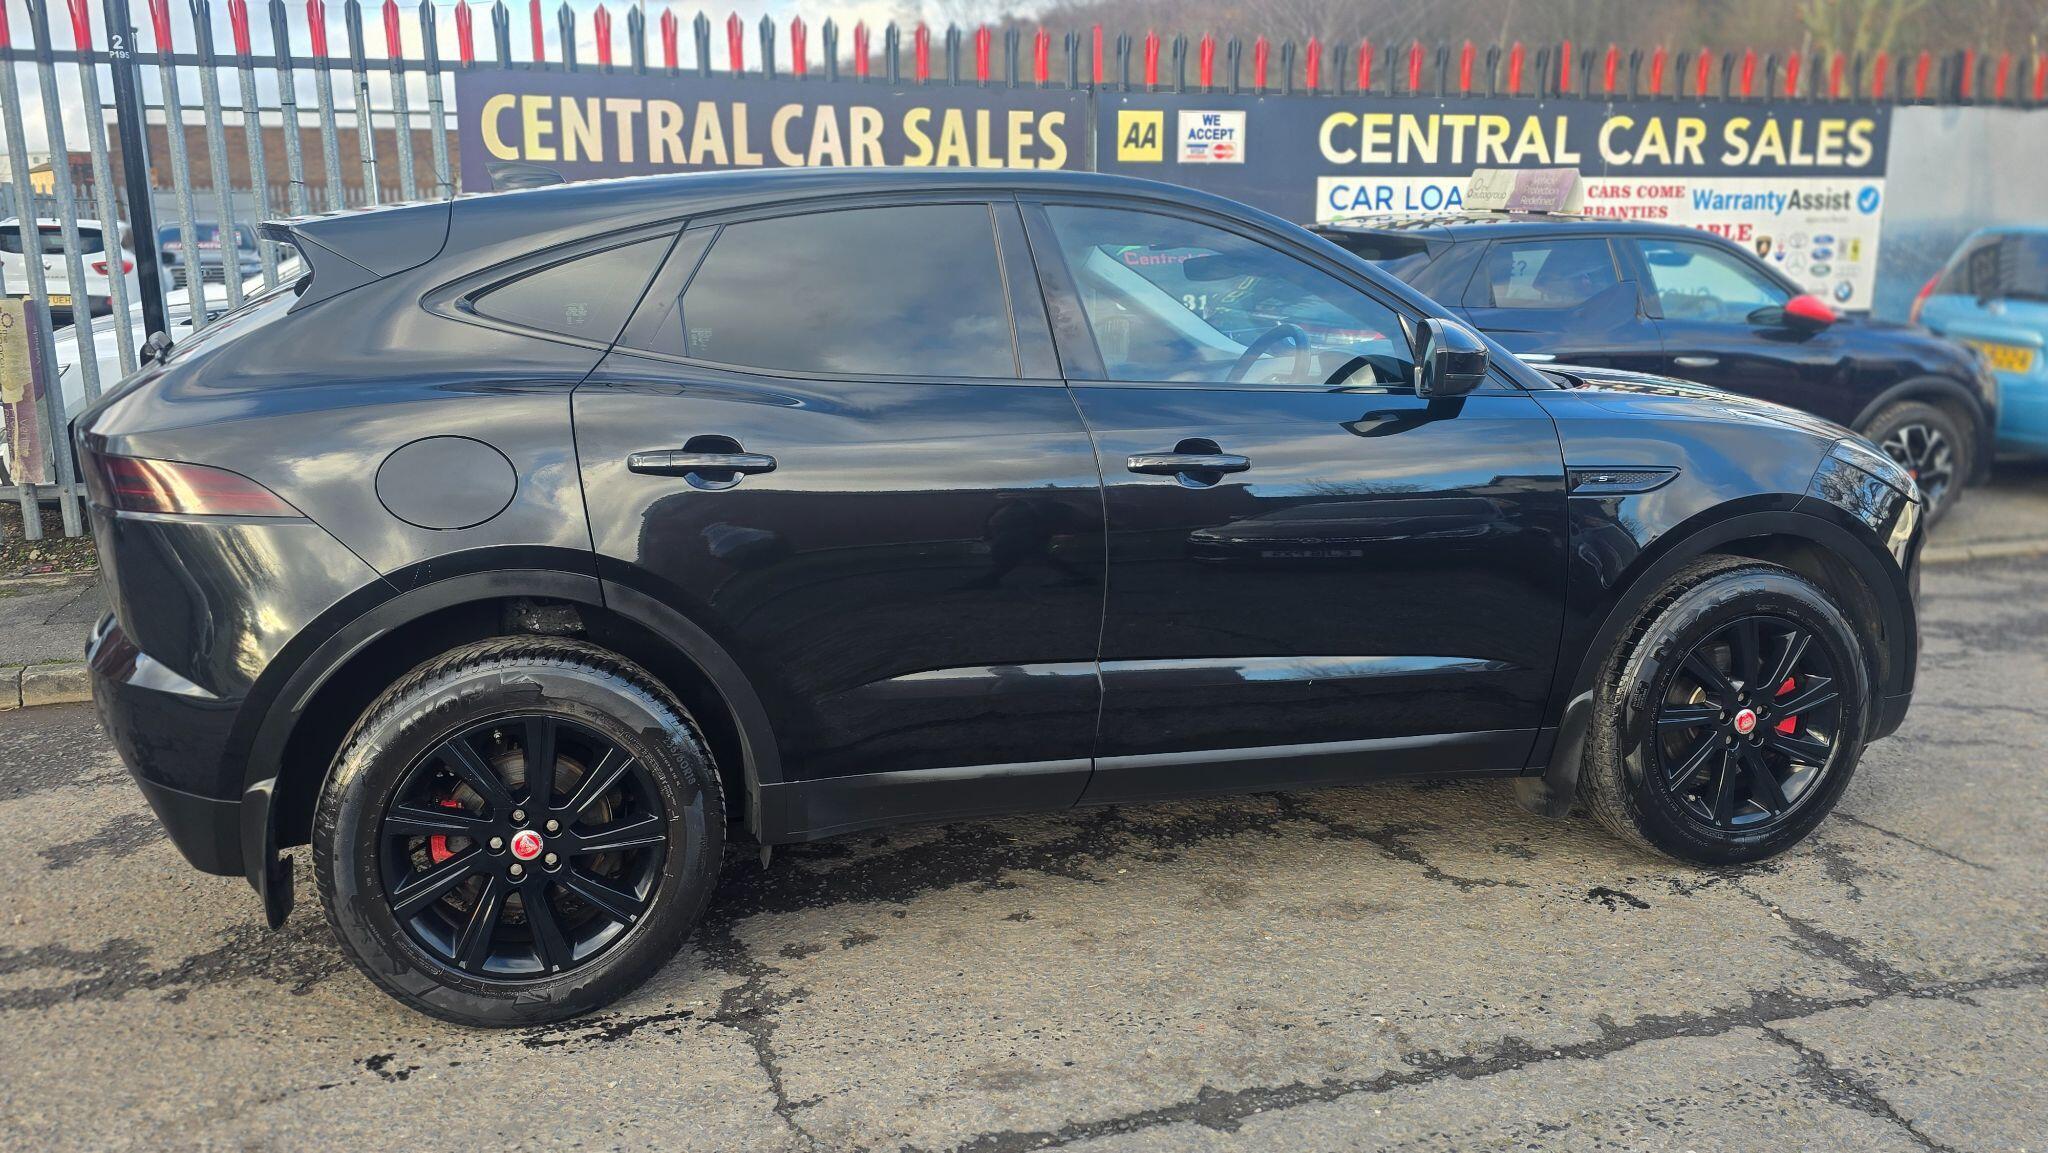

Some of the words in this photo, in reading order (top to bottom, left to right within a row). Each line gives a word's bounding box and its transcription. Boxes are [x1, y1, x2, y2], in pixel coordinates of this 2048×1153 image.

[112, 34, 124, 50] 2
[1202, 114, 1221, 126] WE
[481, 94, 763, 165] CENTRAL
[771, 104, 886, 167] CAR
[903, 107, 1067, 170] SALES
[1123, 122, 1157, 149] AA
[1187, 128, 1235, 140] ACCEPT
[1319, 111, 1581, 165] CENTRAL
[1598, 116, 1707, 166] CAR
[1721, 118, 1875, 167] SALES
[1329, 185, 1393, 211] CAR
[1587, 185, 1631, 199] CARS
[1636, 185, 1686, 199] COME
